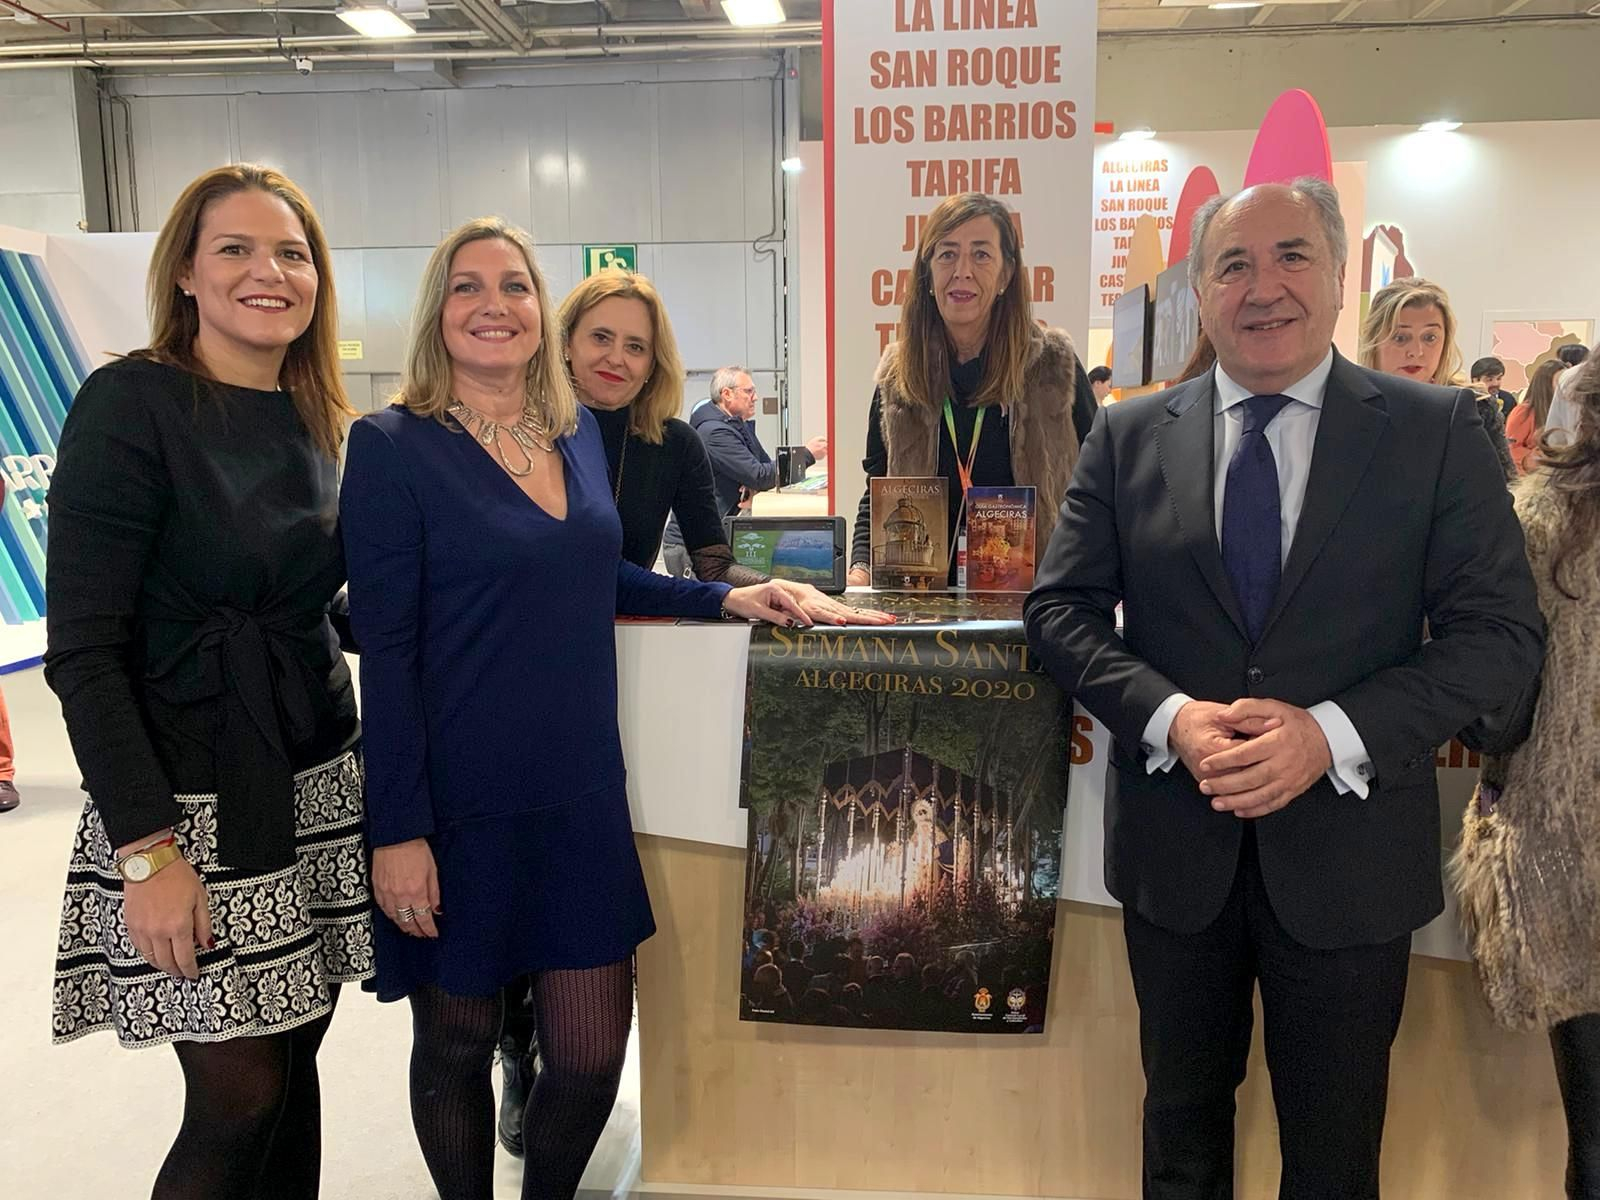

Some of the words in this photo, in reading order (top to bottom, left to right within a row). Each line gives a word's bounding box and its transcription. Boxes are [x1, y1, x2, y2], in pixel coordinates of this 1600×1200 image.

[895, 0, 934, 32] LA
[870, 50, 936, 89] SAN
[947, 46, 1061, 89] ROQUE
[854, 105, 914, 144] LOS
[924, 101, 1076, 142] BARRIOS
[906, 158, 1022, 197] TARIFA
[1110, 179, 1123, 192] LA
[1101, 198, 1125, 212] SAN
[1128, 197, 1168, 212] ROQUE
[1095, 218, 1117, 231] LOS
[1119, 216, 1173, 231] BAOS
[881, 484, 940, 495] ALGECIRAS
[975, 510, 1028, 519] ALGECIRAS
[768, 626, 922, 667] SEMANA
[933, 630, 1044, 672] SANT
[795, 669, 943, 695] ALGECIRAS
[951, 678, 1035, 700] 2020
